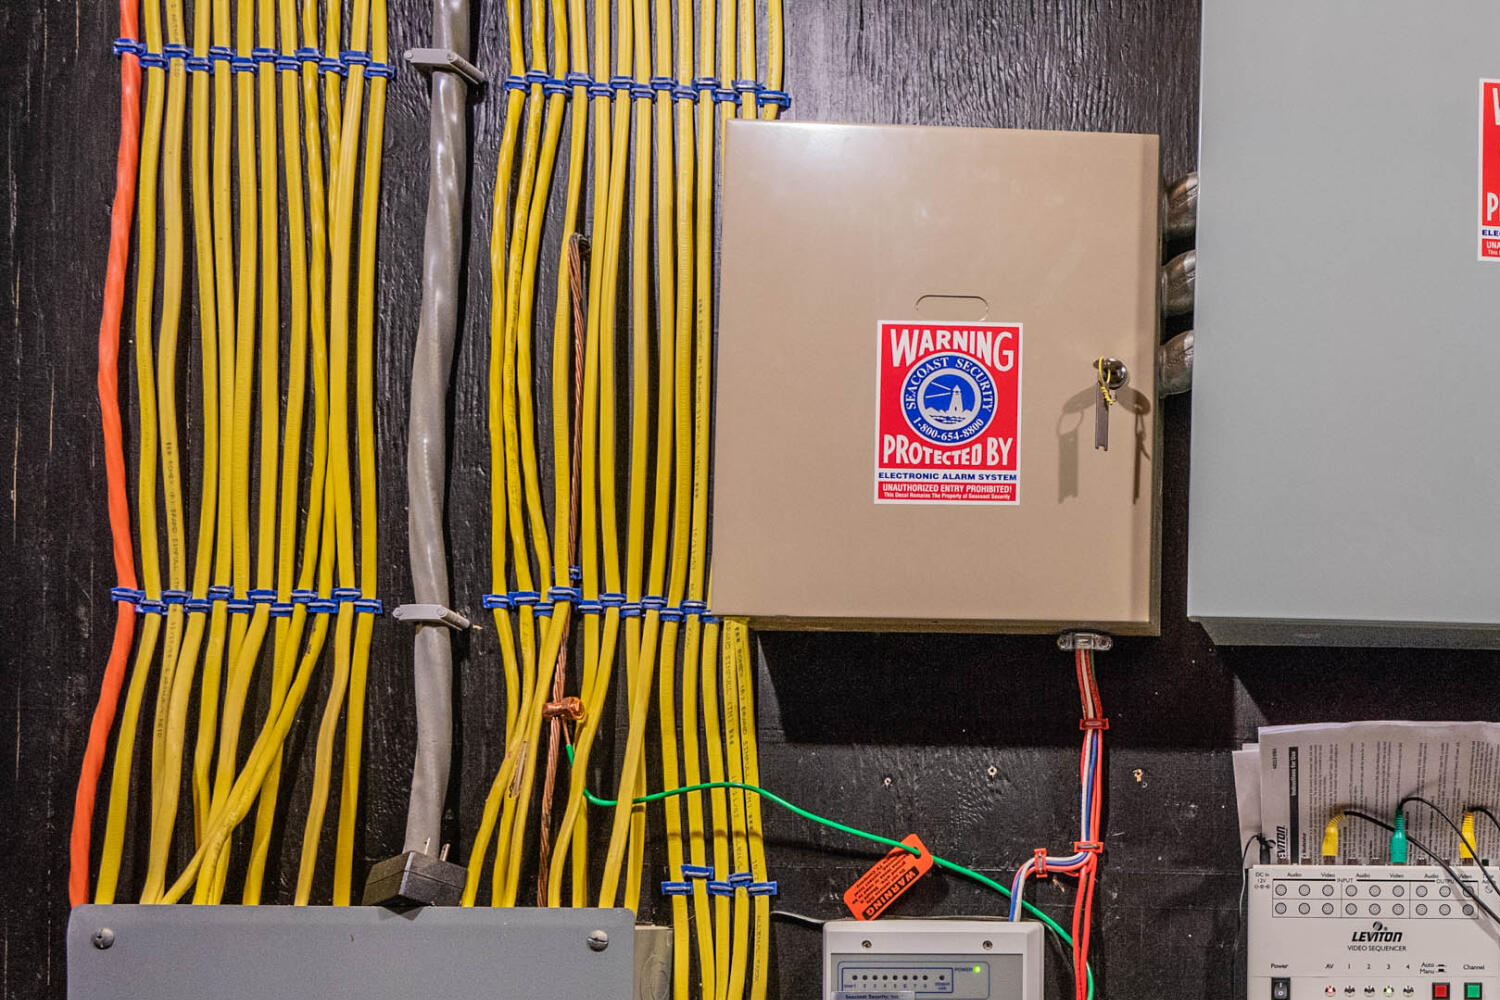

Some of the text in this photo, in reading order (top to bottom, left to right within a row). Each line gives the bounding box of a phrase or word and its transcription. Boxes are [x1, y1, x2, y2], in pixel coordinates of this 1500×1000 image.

[890, 328, 1014, 372] WARNING
[905, 356, 996, 413] SEACOAST SECURITY
[912, 415, 985, 442] 1-800-654-8800
[883, 434, 1013, 466] PROTECTED BY
[878, 472, 1017, 481] ELECTRONIC ALARM SYSTEM
[882, 483, 1012, 493] UNAUTHORIZED ENTRY PROHIBITED!
[866, 870, 917, 916] WARNING
[1347, 944, 1407, 952] VIDEO SEQUENCER
[1351, 931, 1403, 942] LEVITON
